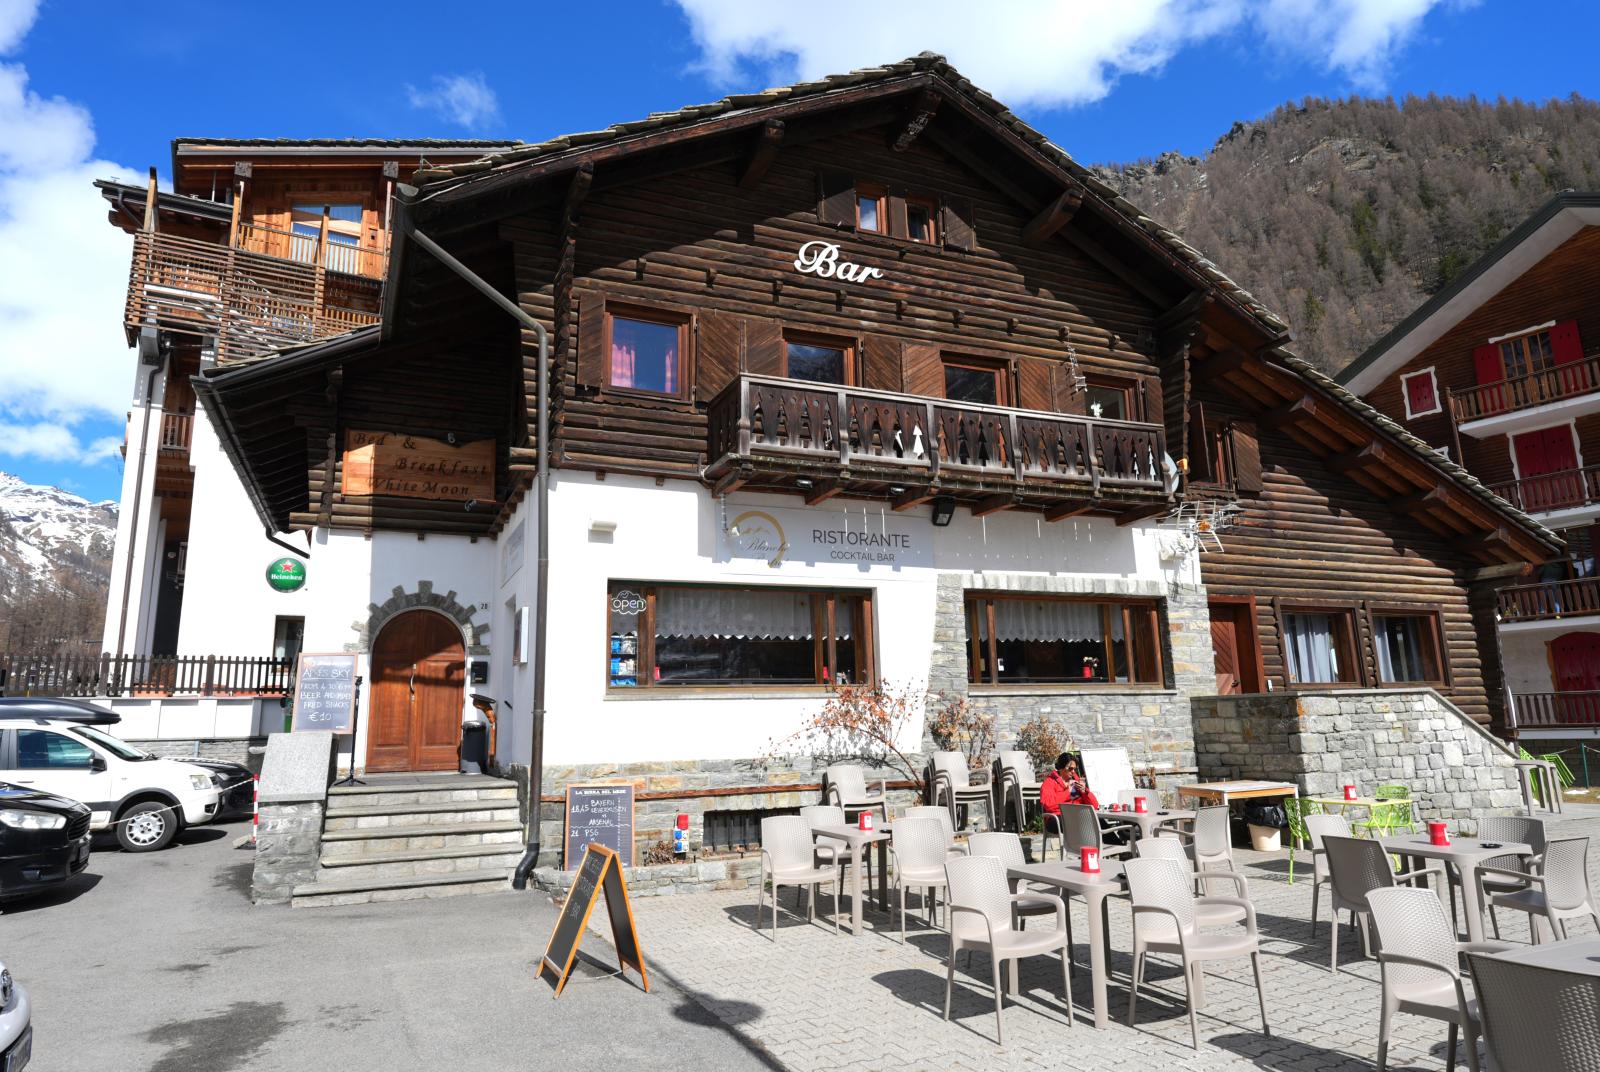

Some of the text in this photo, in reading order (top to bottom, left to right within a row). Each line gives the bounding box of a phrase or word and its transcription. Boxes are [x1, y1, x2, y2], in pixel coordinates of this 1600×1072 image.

[793, 241, 884, 283] Bar
[353, 432, 417, 450] Bed &
[395, 457, 490, 476] Breakfast
[367, 477, 470, 496] White Moon
[812, 529, 911, 549] RISTORANTE
[830, 550, 896, 562] COCKTAIL BAR
[271, 573, 303, 581] Heineken
[612, 599, 644, 610] open
[330, 669, 352, 678] SKY
[301, 691, 321, 699] BEER
[303, 701, 322, 709] FRIED
[588, 818, 614, 827] ARSENAL
